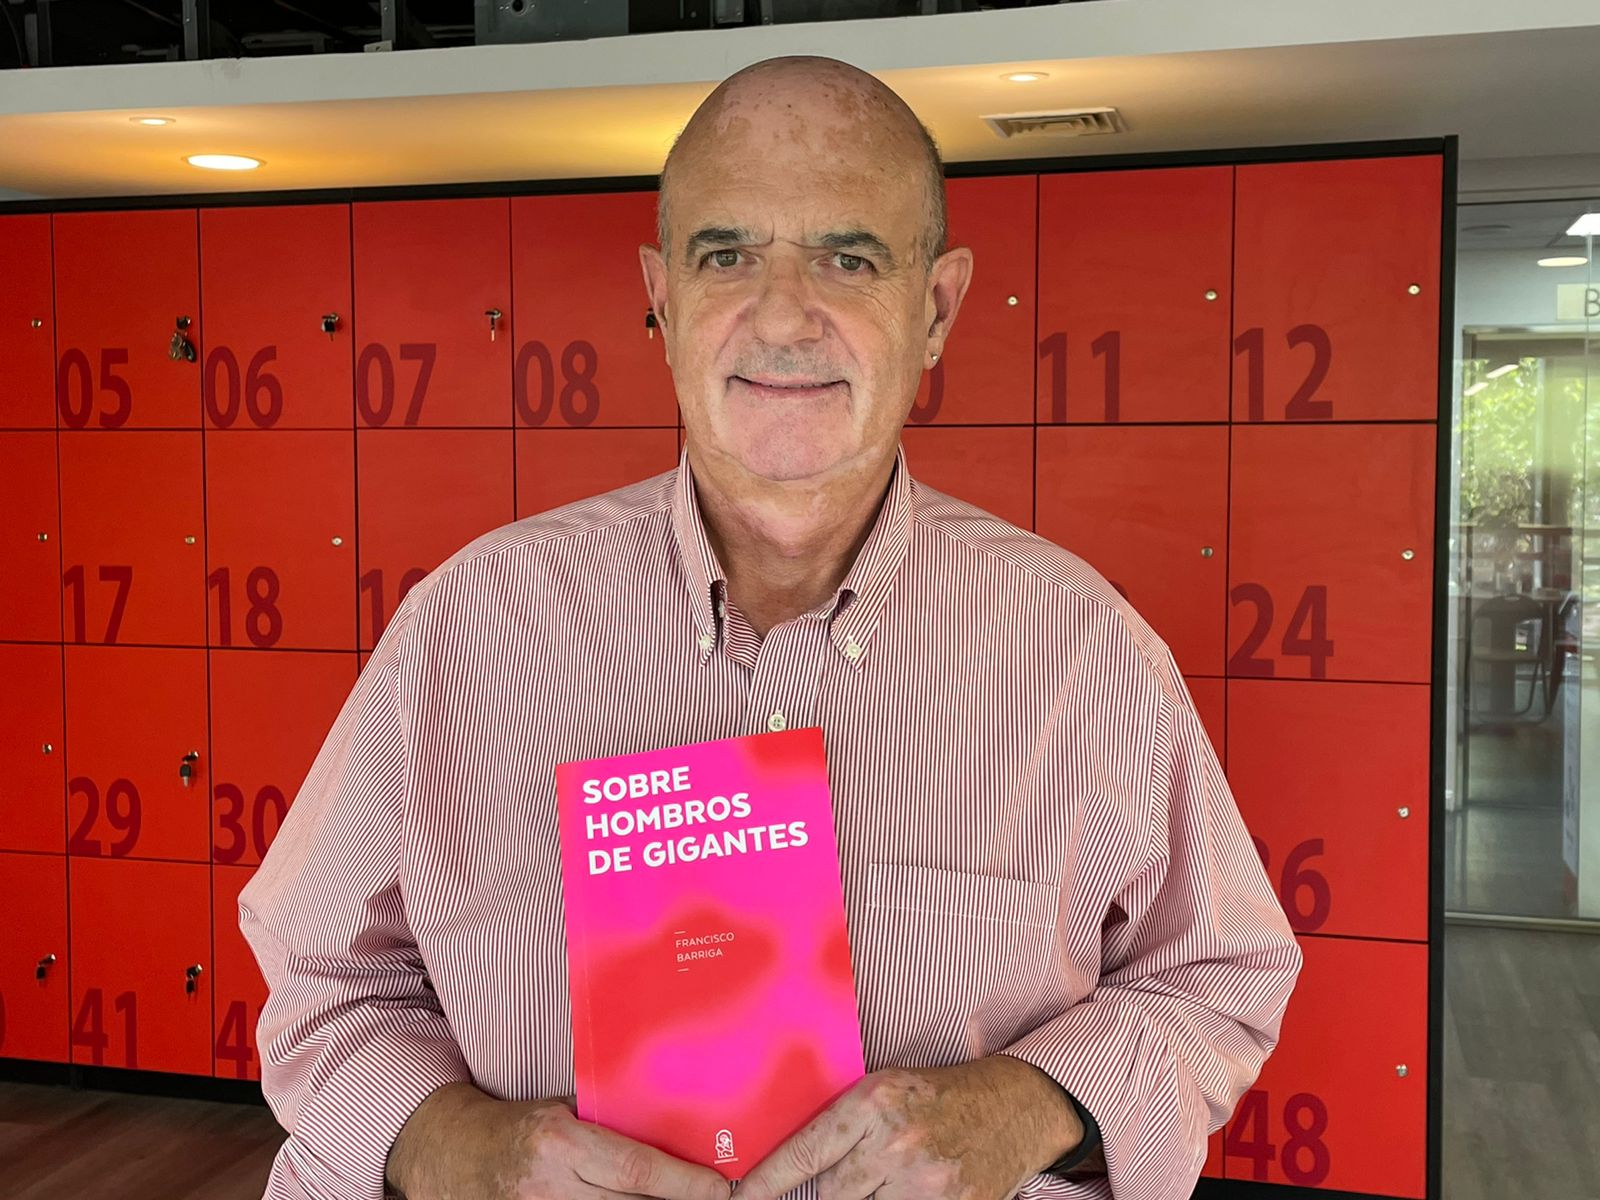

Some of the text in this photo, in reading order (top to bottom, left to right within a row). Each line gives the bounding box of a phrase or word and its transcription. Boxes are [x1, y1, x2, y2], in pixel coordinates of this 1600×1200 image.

[57, 348, 132, 428] 05
[204, 346, 283, 428] 06
[356, 342, 436, 427] 07
[515, 340, 599, 427] 08
[1038, 331, 1121, 423] 11
[1234, 324, 1333, 421] 12
[63, 565, 133, 645] 17
[207, 566, 282, 648] 18
[1228, 583, 1334, 679] 24
[68, 776, 141, 857] 29
[213, 783, 288, 863] 30
[582, 766, 691, 804] SOBRE
[585, 793, 752, 839] HOMBROS
[588, 821, 809, 875] DE GIGANTES
[1252, 835, 1331, 933] 6
[675, 932, 735, 949] FRANCISCO
[677, 947, 723, 963] BARRIGA
[72, 988, 138, 1069] 41
[1226, 1089, 1331, 1187] 48
